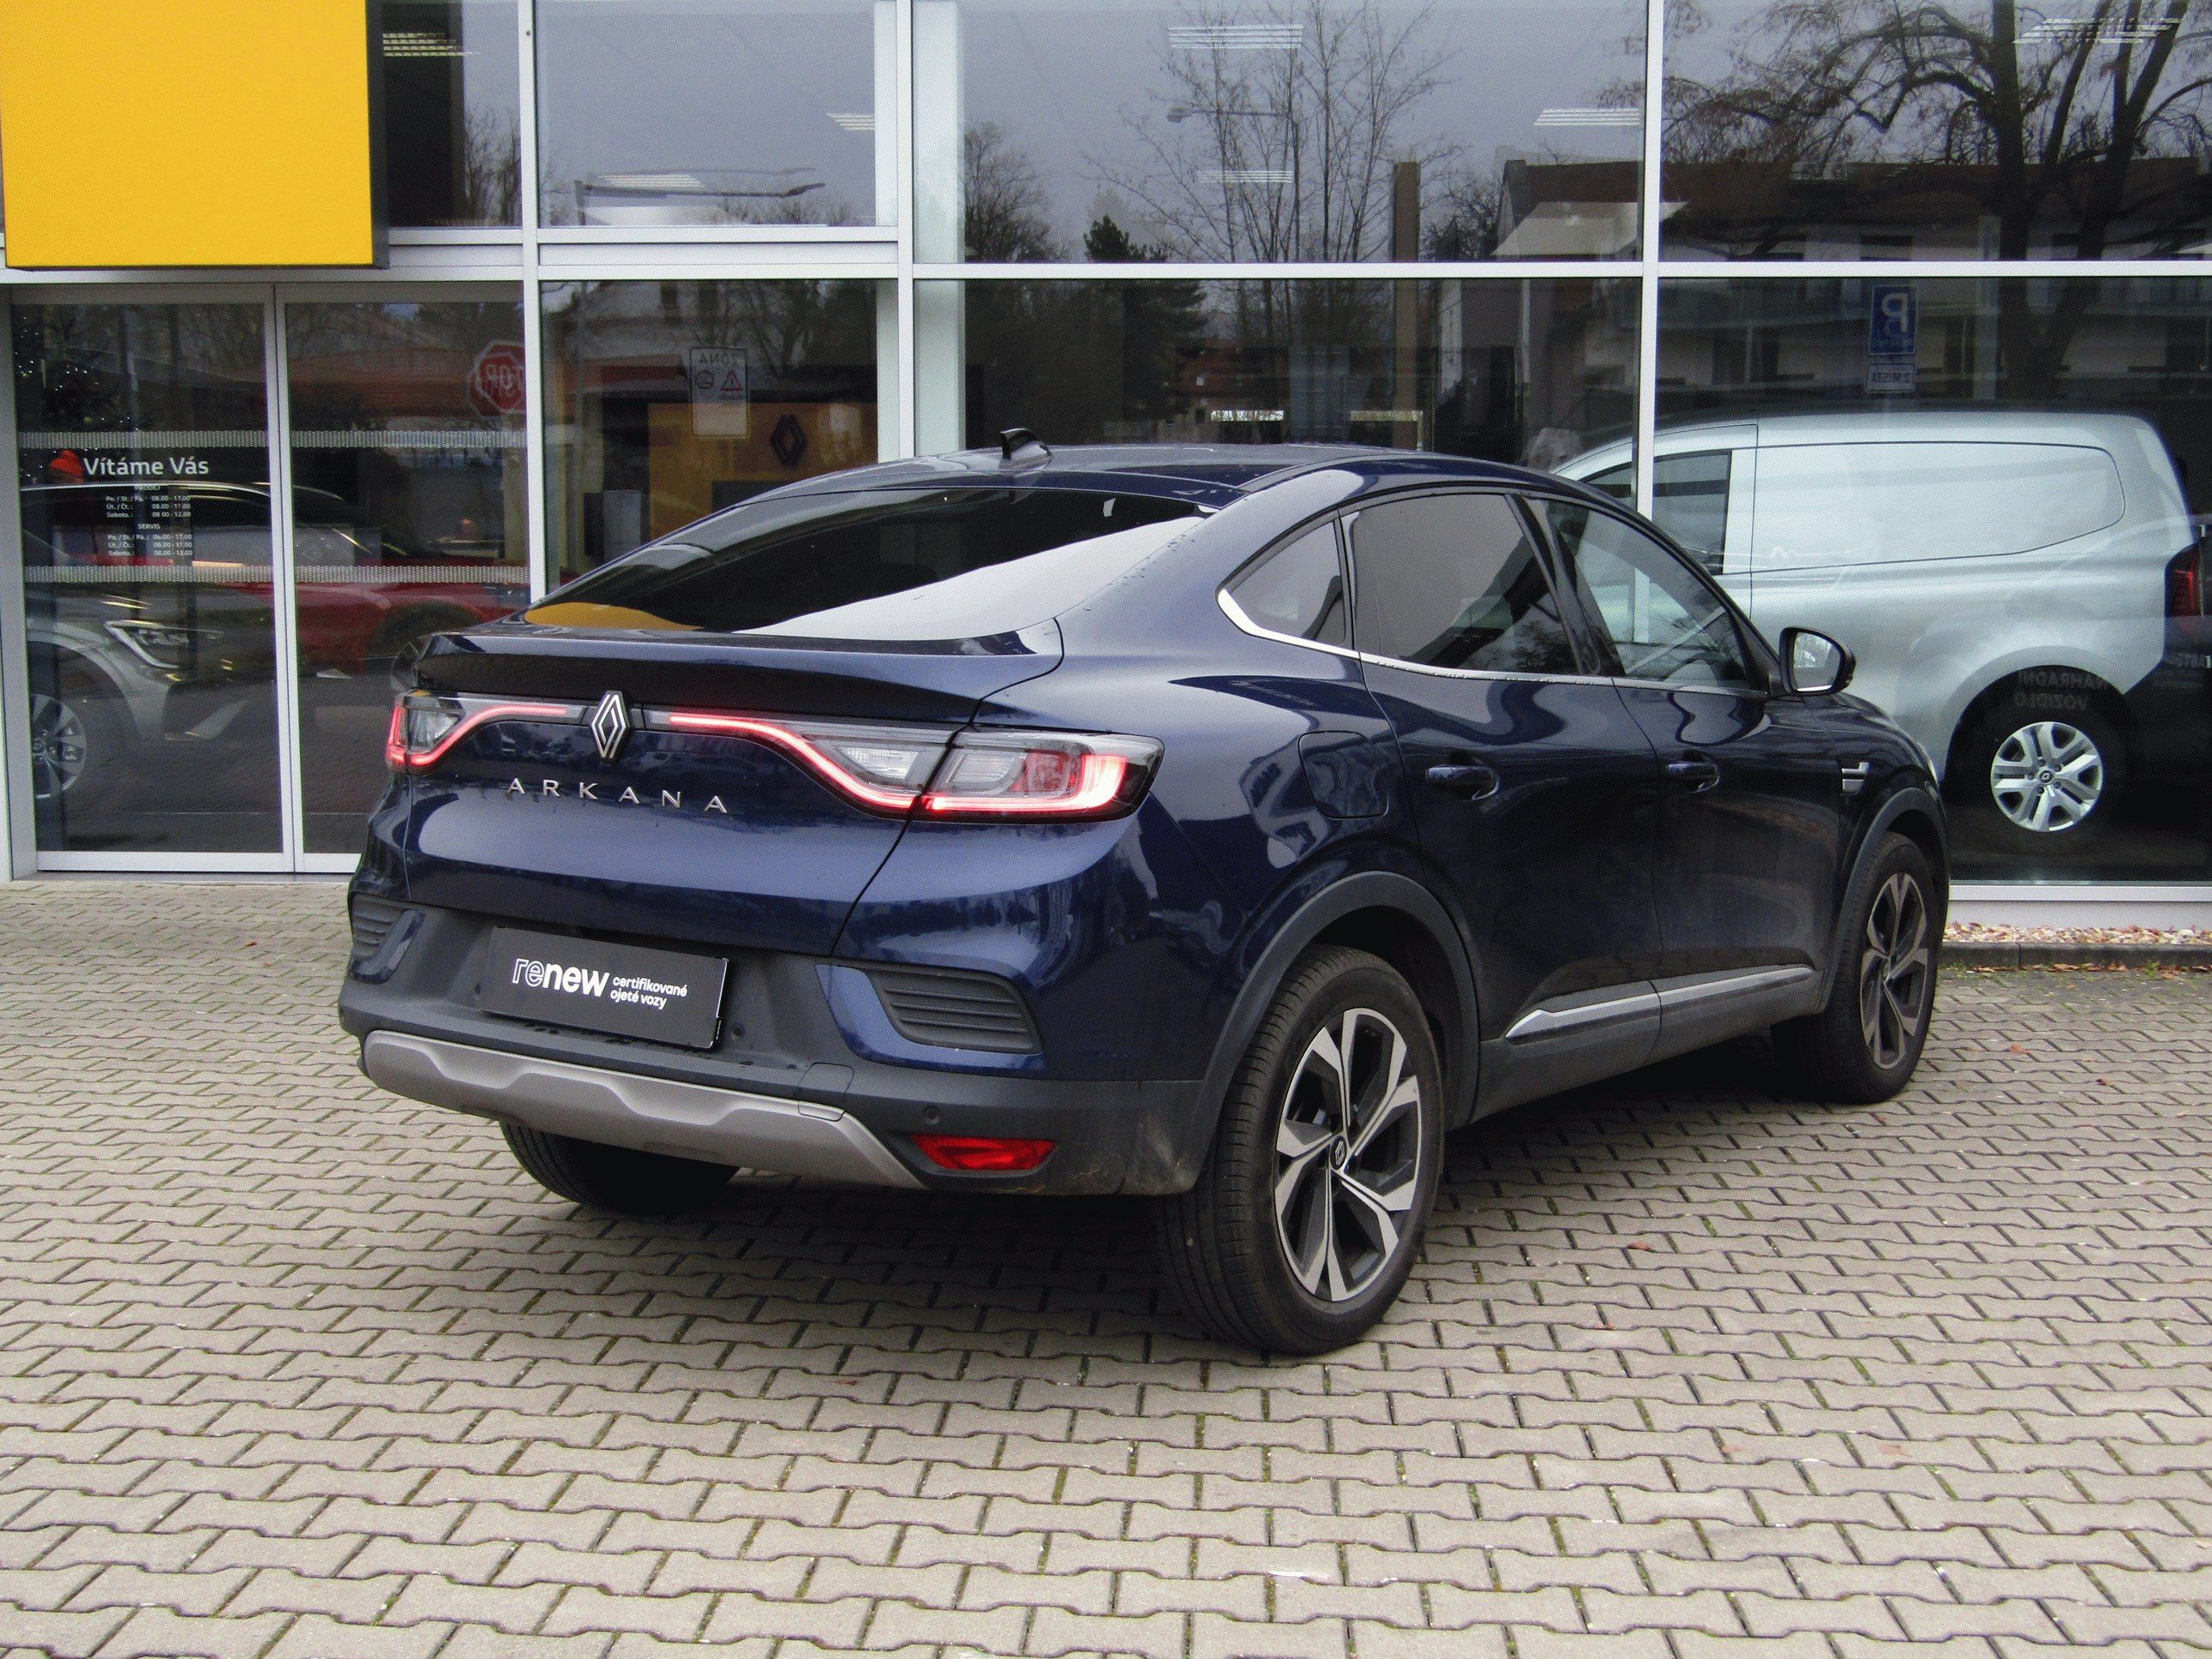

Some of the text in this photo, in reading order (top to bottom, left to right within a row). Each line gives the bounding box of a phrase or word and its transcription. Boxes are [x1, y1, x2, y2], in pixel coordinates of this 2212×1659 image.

[83, 455, 209, 476] Vítáme Vás
[507, 777, 728, 813] ARKANA
[512, 958, 610, 997] renew
[612, 975, 688, 997] certifikované
[610, 988, 668, 1009] ojeté vozy
